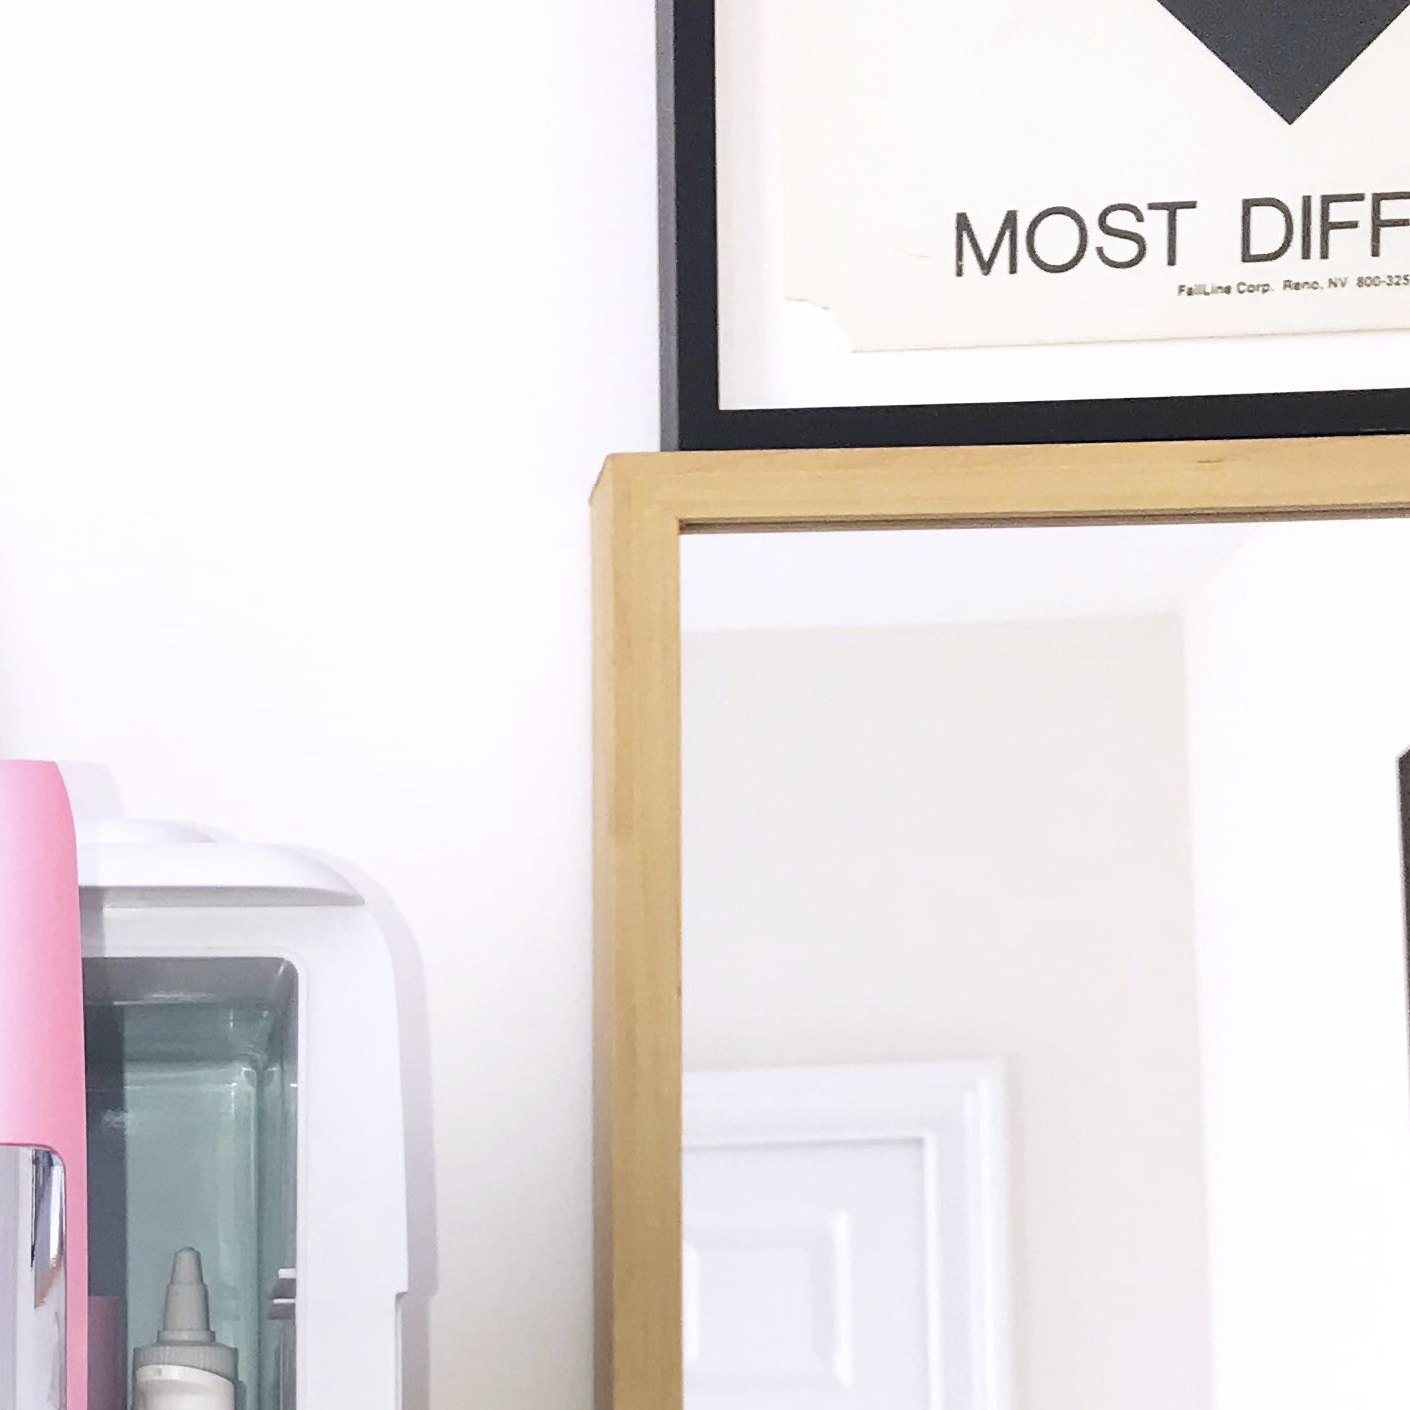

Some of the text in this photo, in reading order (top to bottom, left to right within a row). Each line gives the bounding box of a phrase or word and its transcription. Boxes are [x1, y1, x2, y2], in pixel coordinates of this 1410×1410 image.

[955, 191, 1410, 277] MOST DIFF
[1236, 281, 1275, 295] Corp.
[1327, 277, 1348, 288] NV
